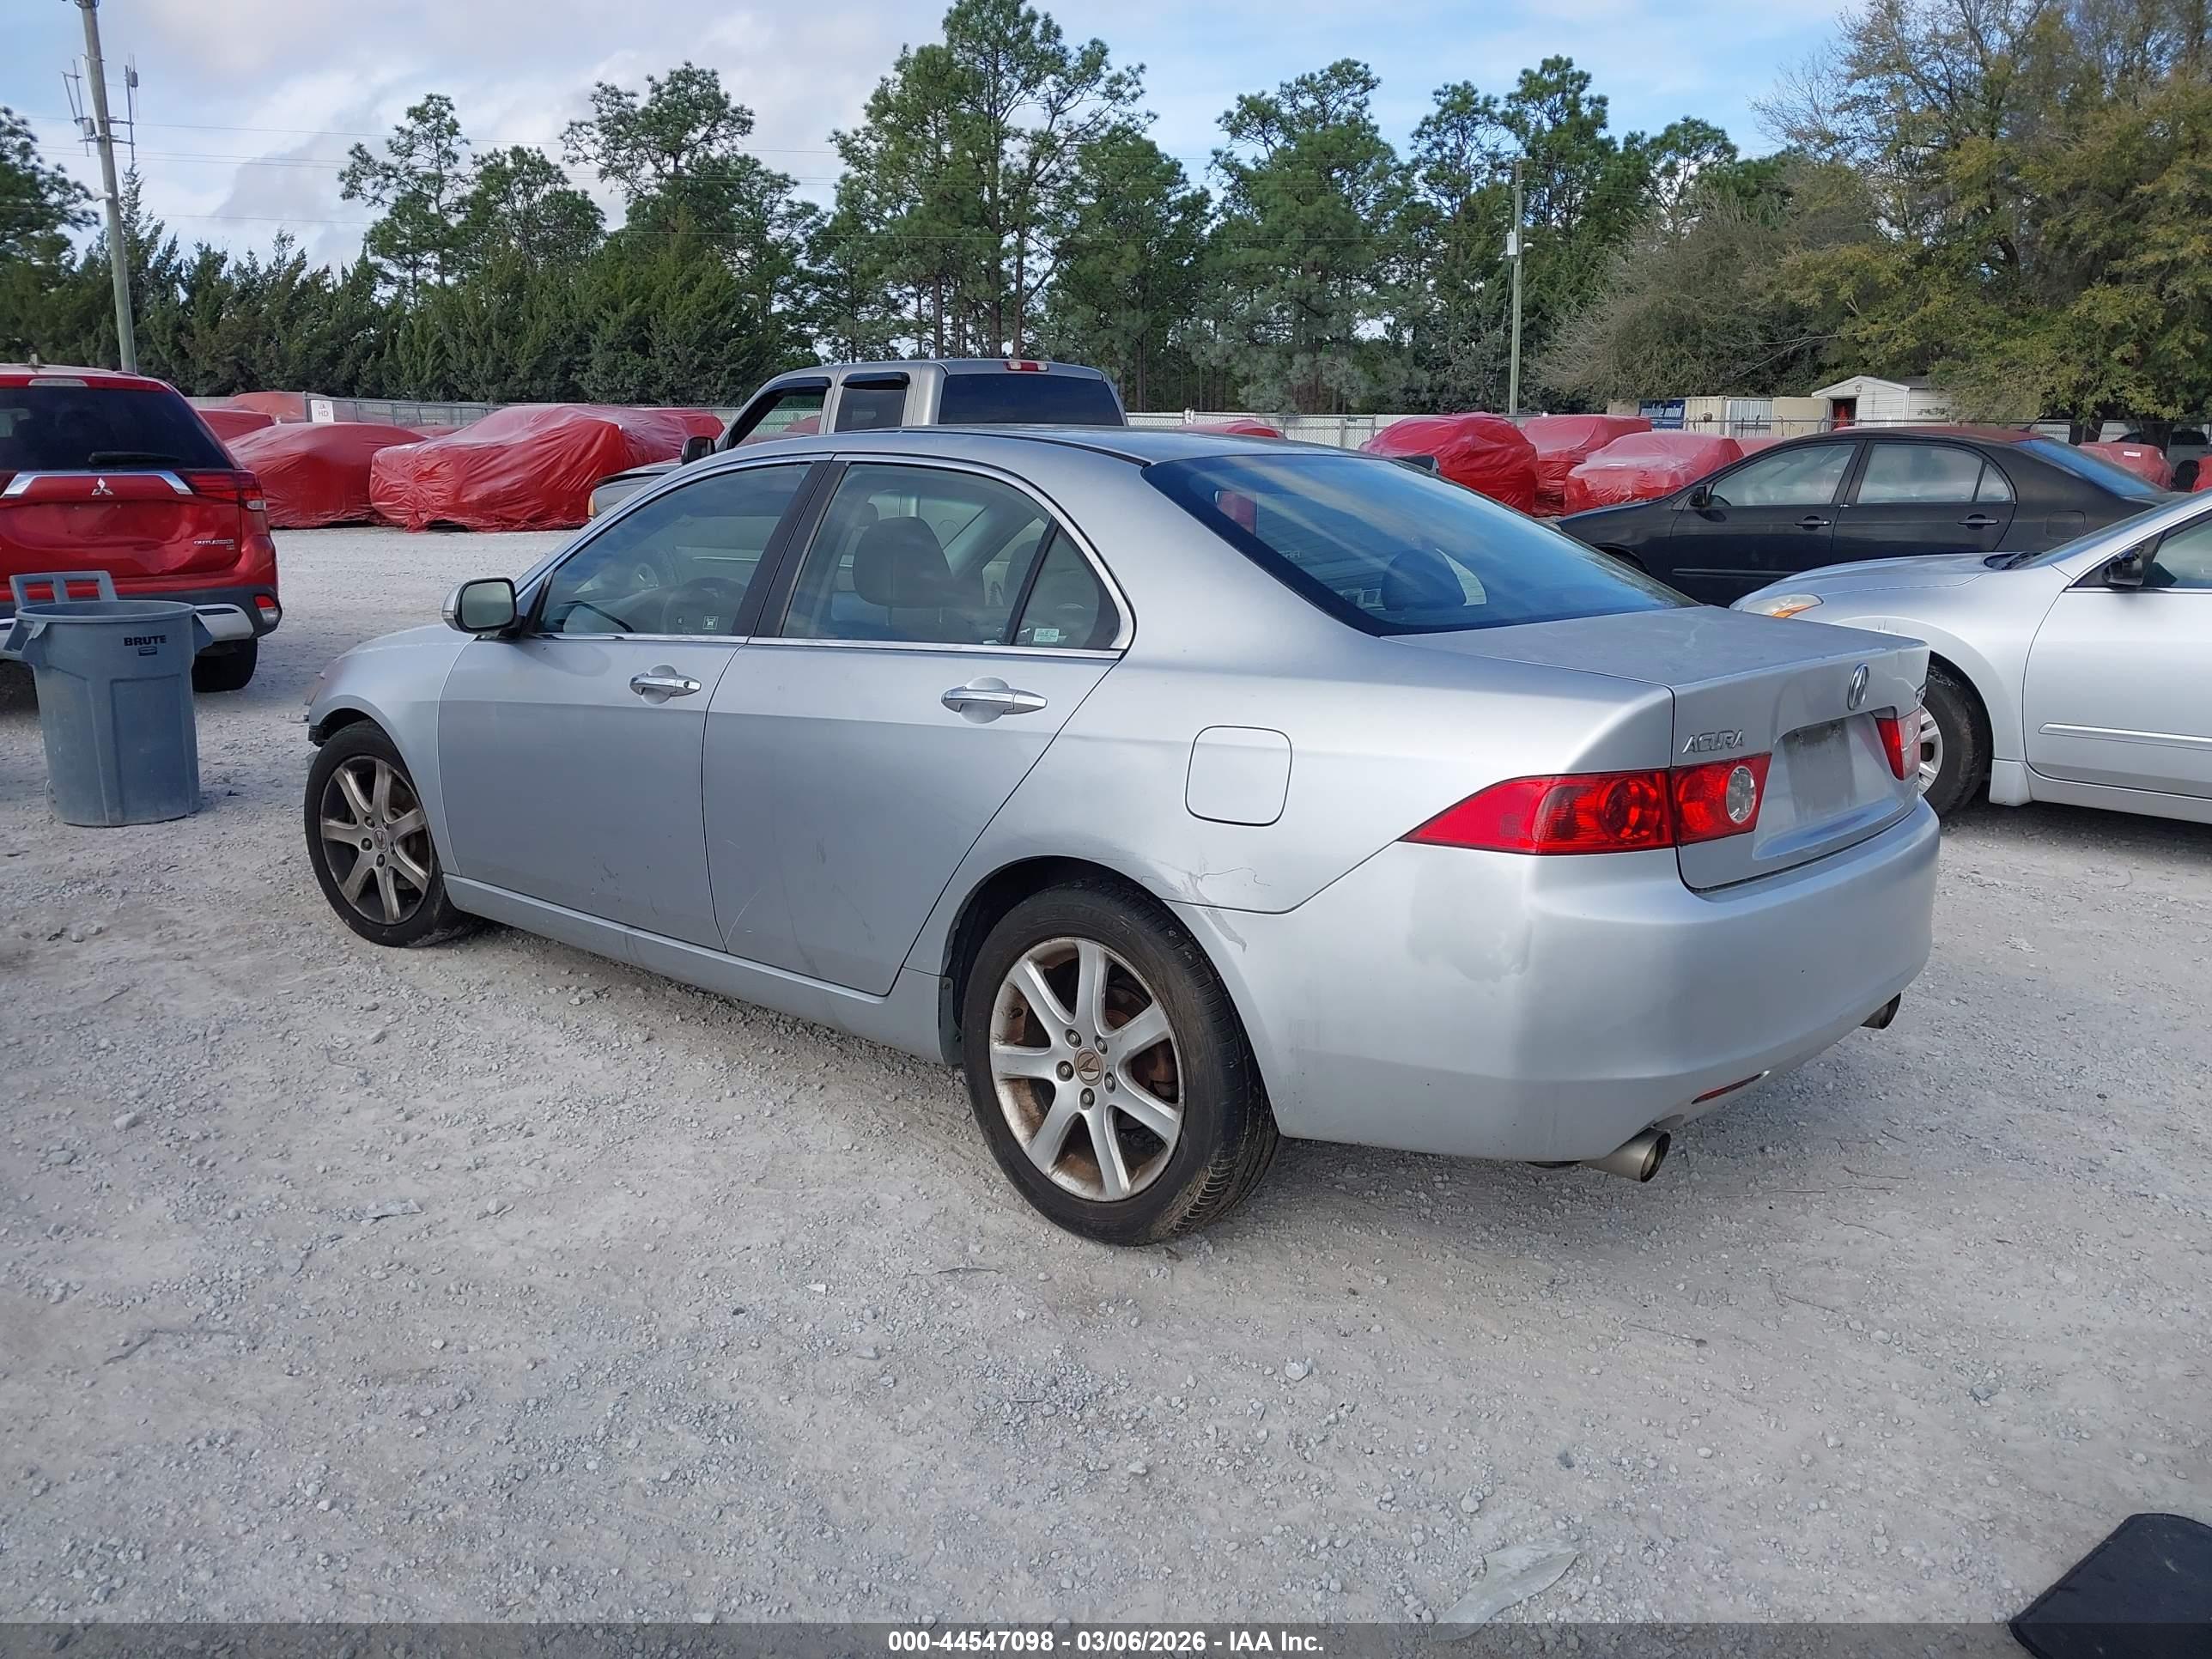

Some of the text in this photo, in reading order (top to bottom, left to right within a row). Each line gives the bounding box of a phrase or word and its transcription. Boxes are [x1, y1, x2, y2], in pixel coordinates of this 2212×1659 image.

[1640, 404, 1684, 417] mobile mini
[124, 635, 167, 646] BRUTE
[1682, 730, 1743, 754] ACURA
